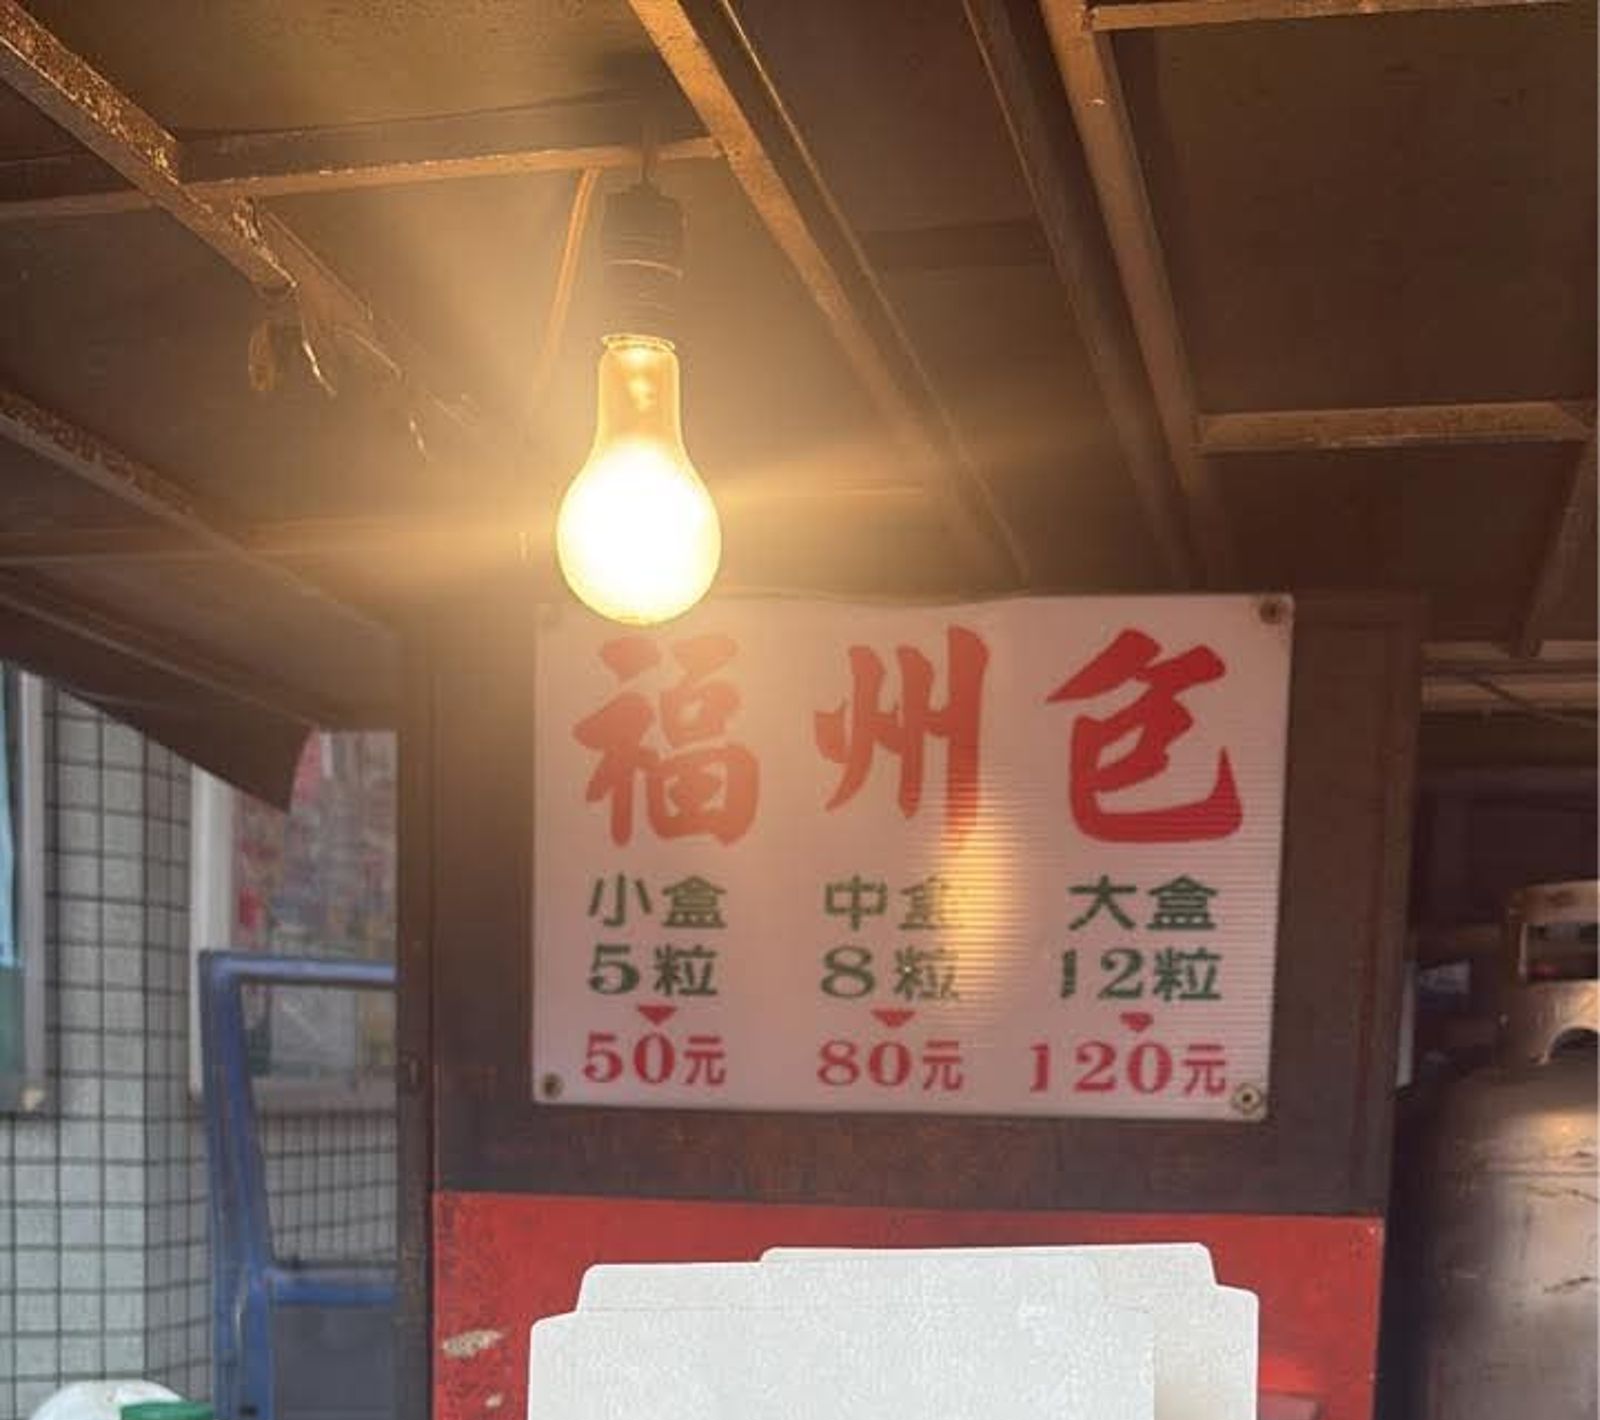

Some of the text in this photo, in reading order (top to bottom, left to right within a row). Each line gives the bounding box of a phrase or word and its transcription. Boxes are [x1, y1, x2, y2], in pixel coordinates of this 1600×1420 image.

[572, 625, 1243, 848] 福州包
[587, 873, 728, 929] 小盒
[1068, 874, 1219, 931] 大盒
[588, 944, 1222, 1001] 5粒 8粒 12粒
[582, 1031, 1228, 1094] 50元 80元 120元
